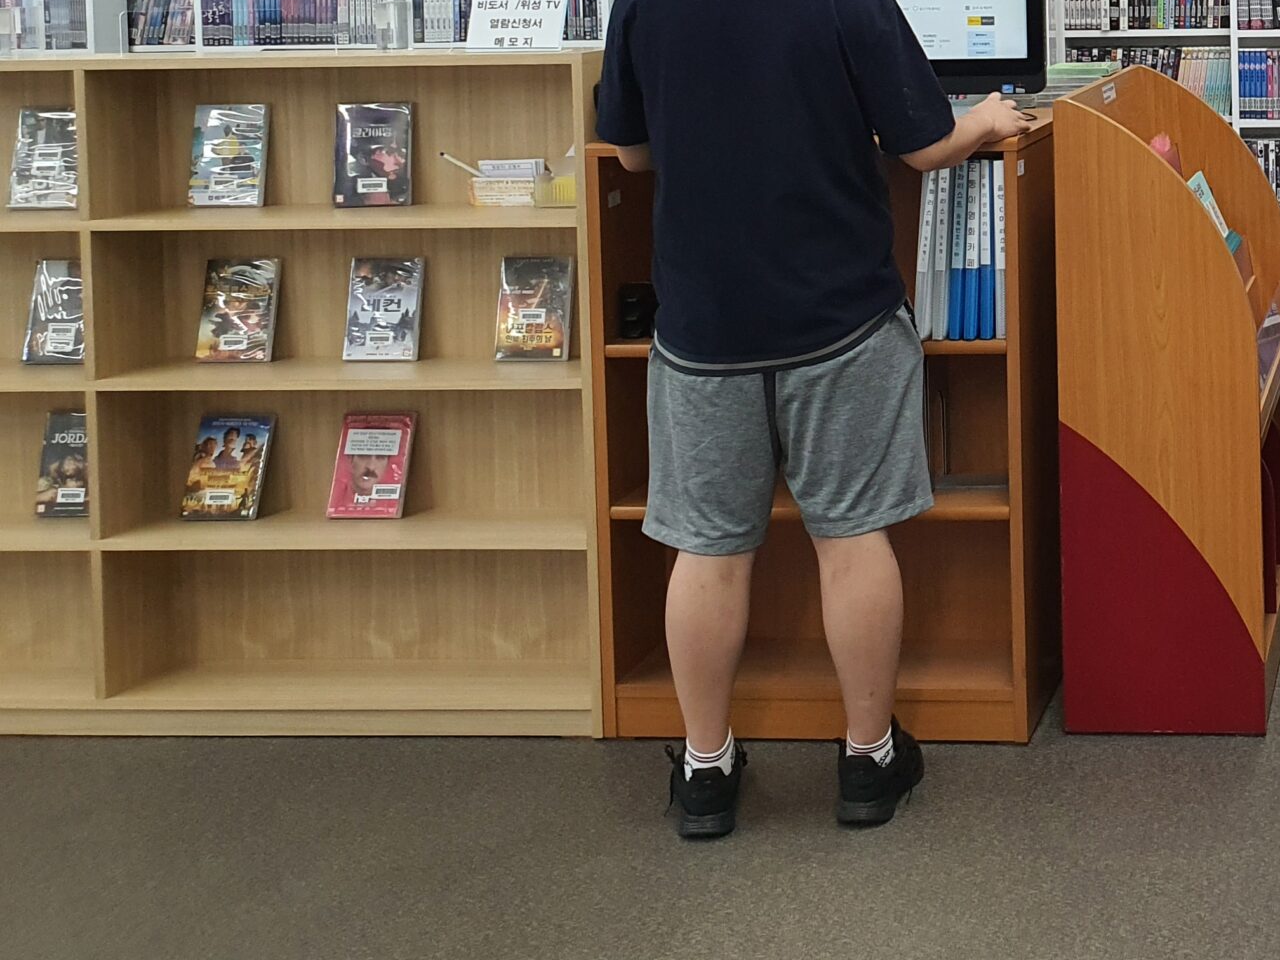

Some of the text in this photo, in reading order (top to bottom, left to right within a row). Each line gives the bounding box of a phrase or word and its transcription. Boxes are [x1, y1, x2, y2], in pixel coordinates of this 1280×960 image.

[477, 0, 508, 11] 비도서
[546, 0, 561, 10] TV
[489, 18, 543, 29] 열람신청서
